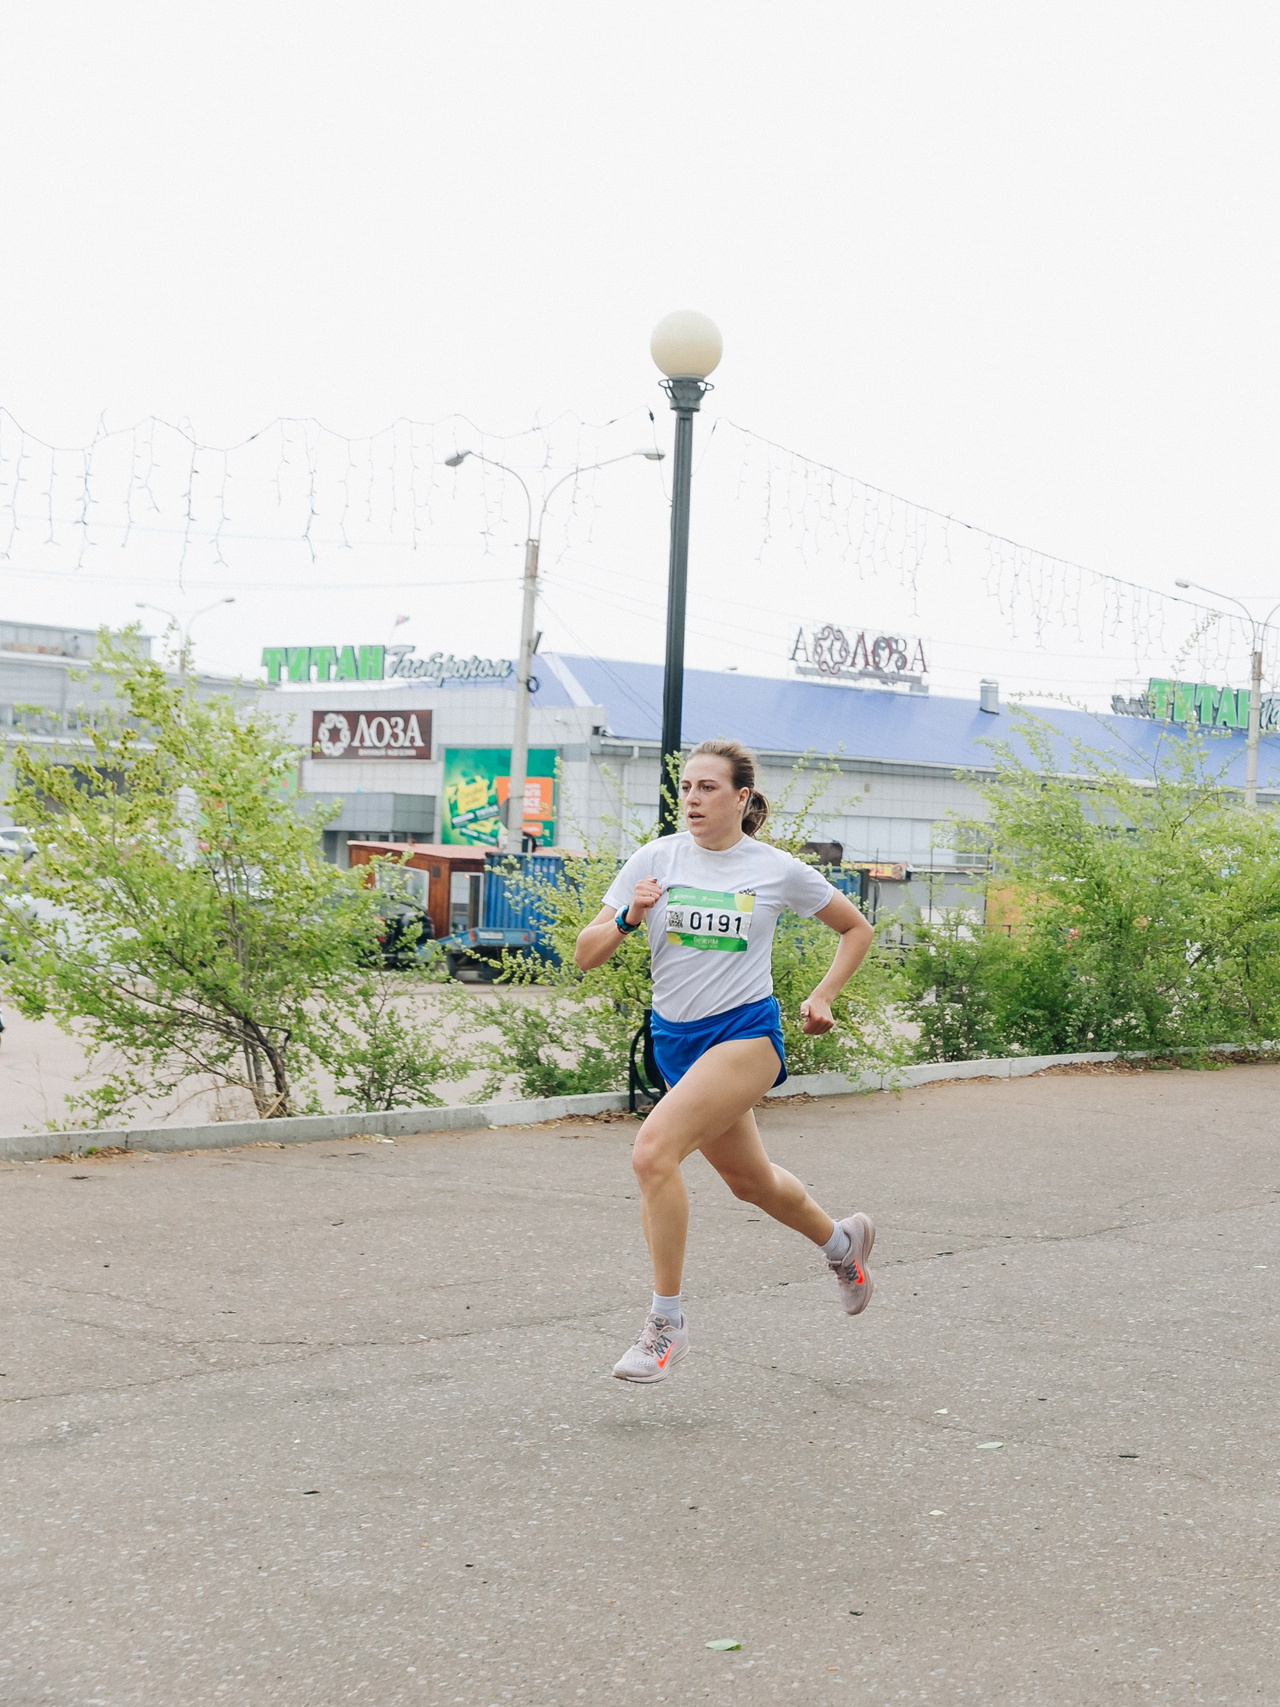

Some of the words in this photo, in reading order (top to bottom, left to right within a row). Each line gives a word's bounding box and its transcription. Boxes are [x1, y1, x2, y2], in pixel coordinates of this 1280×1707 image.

[261, 645, 385, 682] ТИТАН
[350, 713, 425, 748] ЛОЗА
[690, 911, 742, 934] 0191
